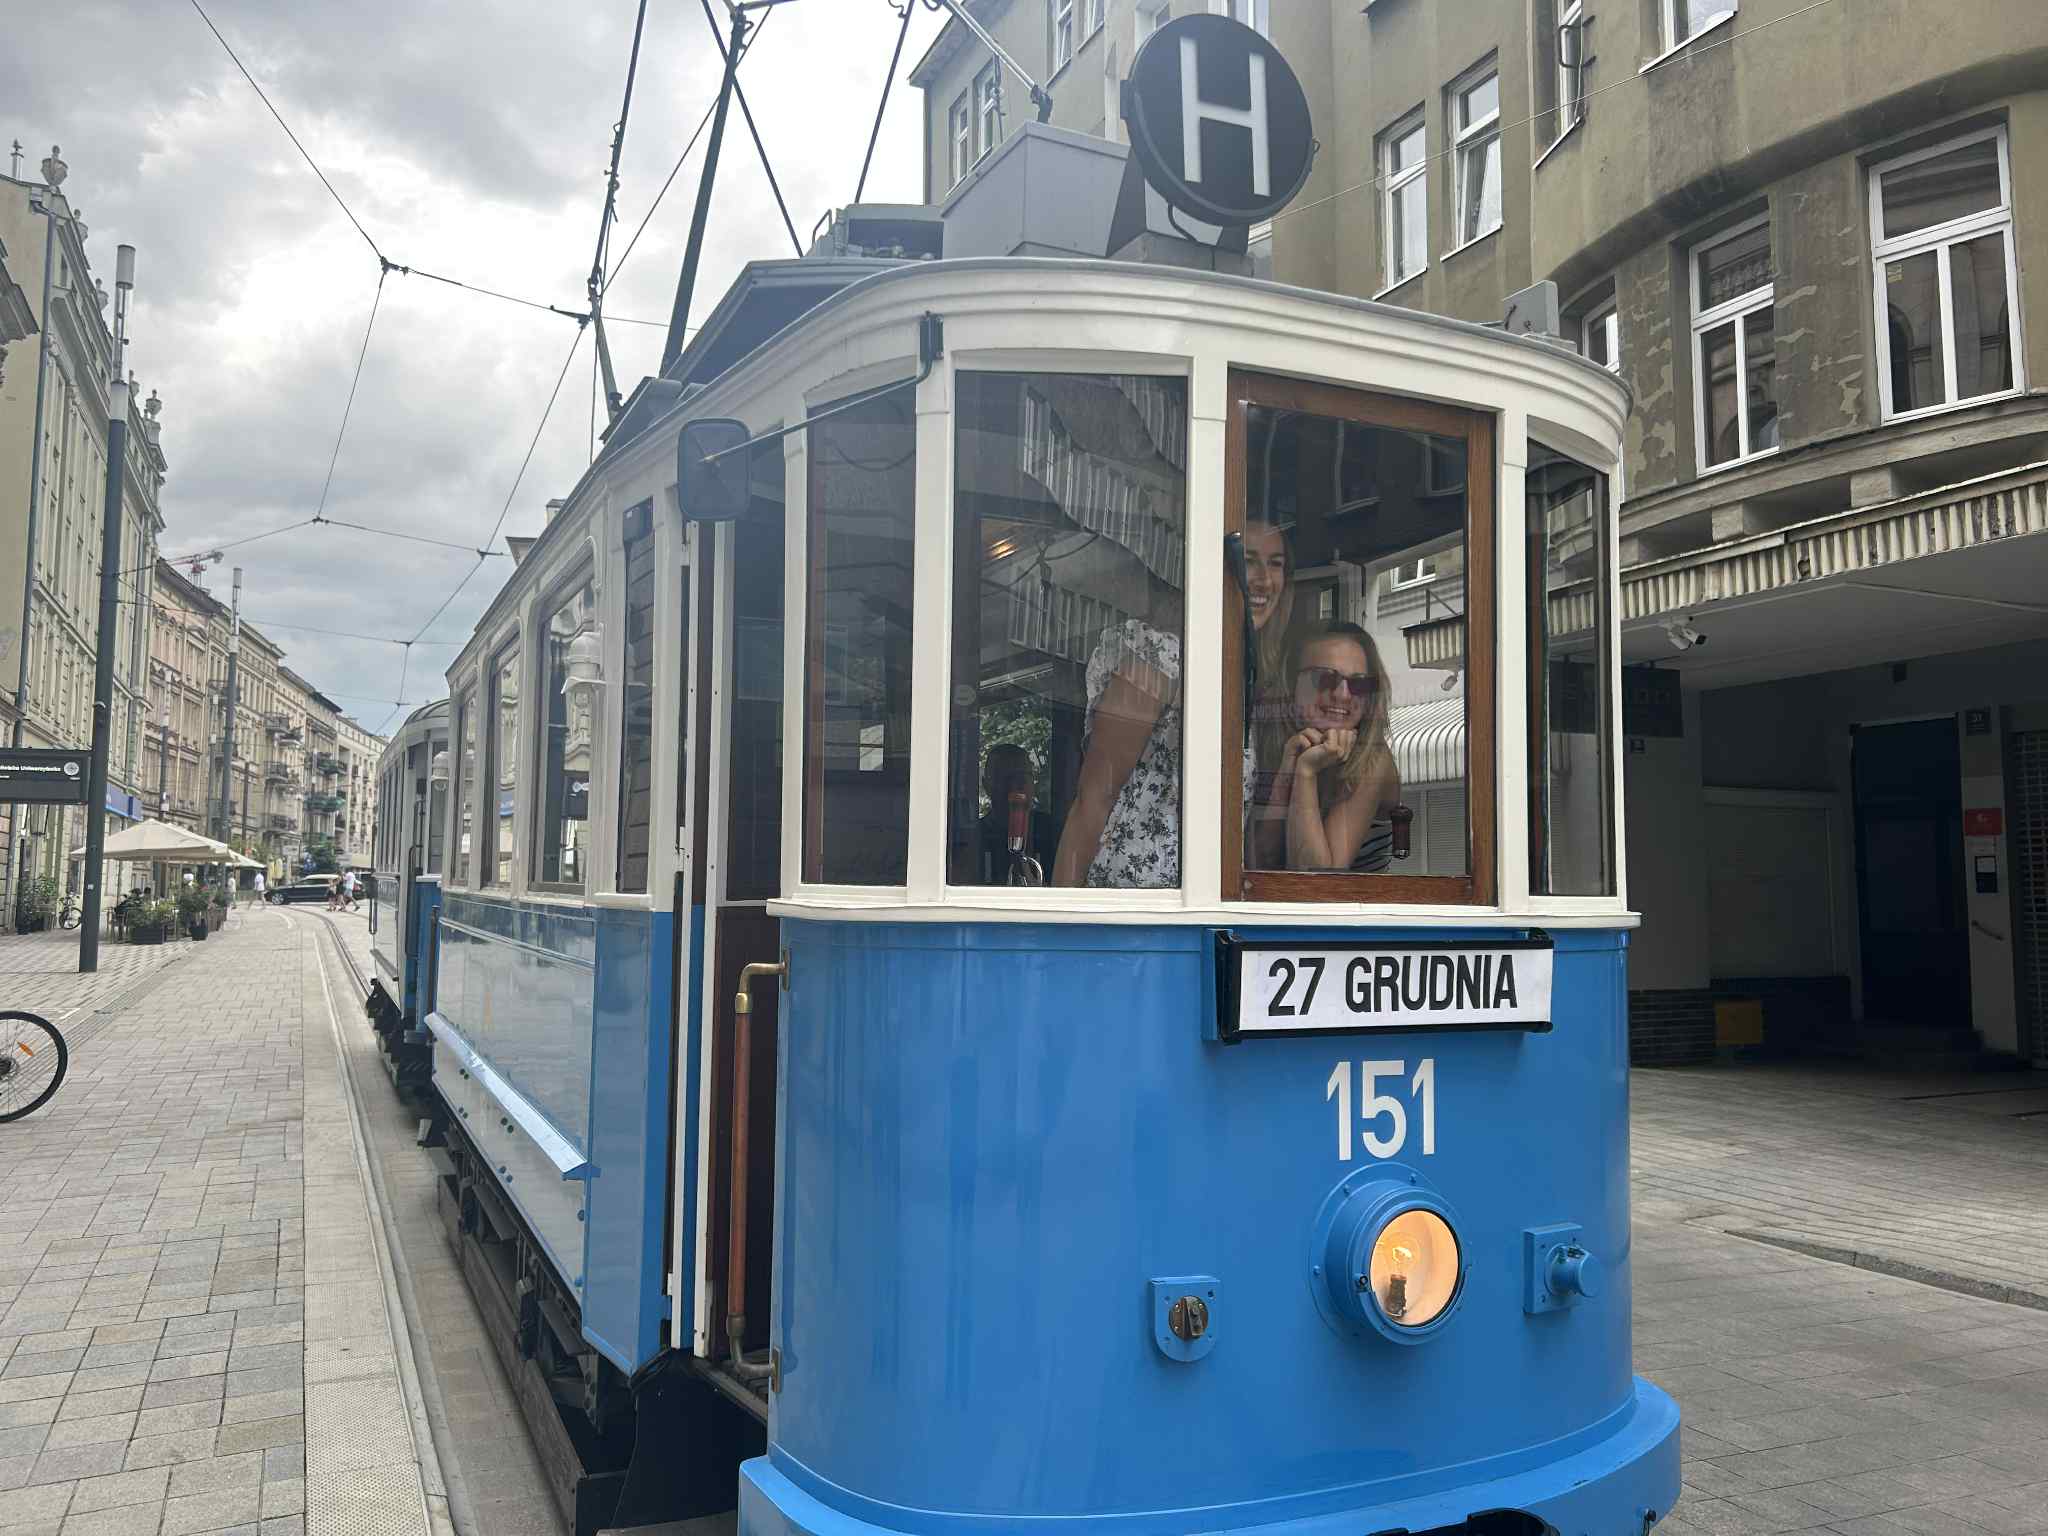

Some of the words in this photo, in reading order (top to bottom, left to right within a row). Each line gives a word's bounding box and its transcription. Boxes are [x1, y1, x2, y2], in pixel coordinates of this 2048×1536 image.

[1180, 37, 1271, 197] H
[1268, 957, 1326, 1017] 27
[1345, 953, 1518, 1013] GRUDNIA
[1326, 1058, 1435, 1160] 151
